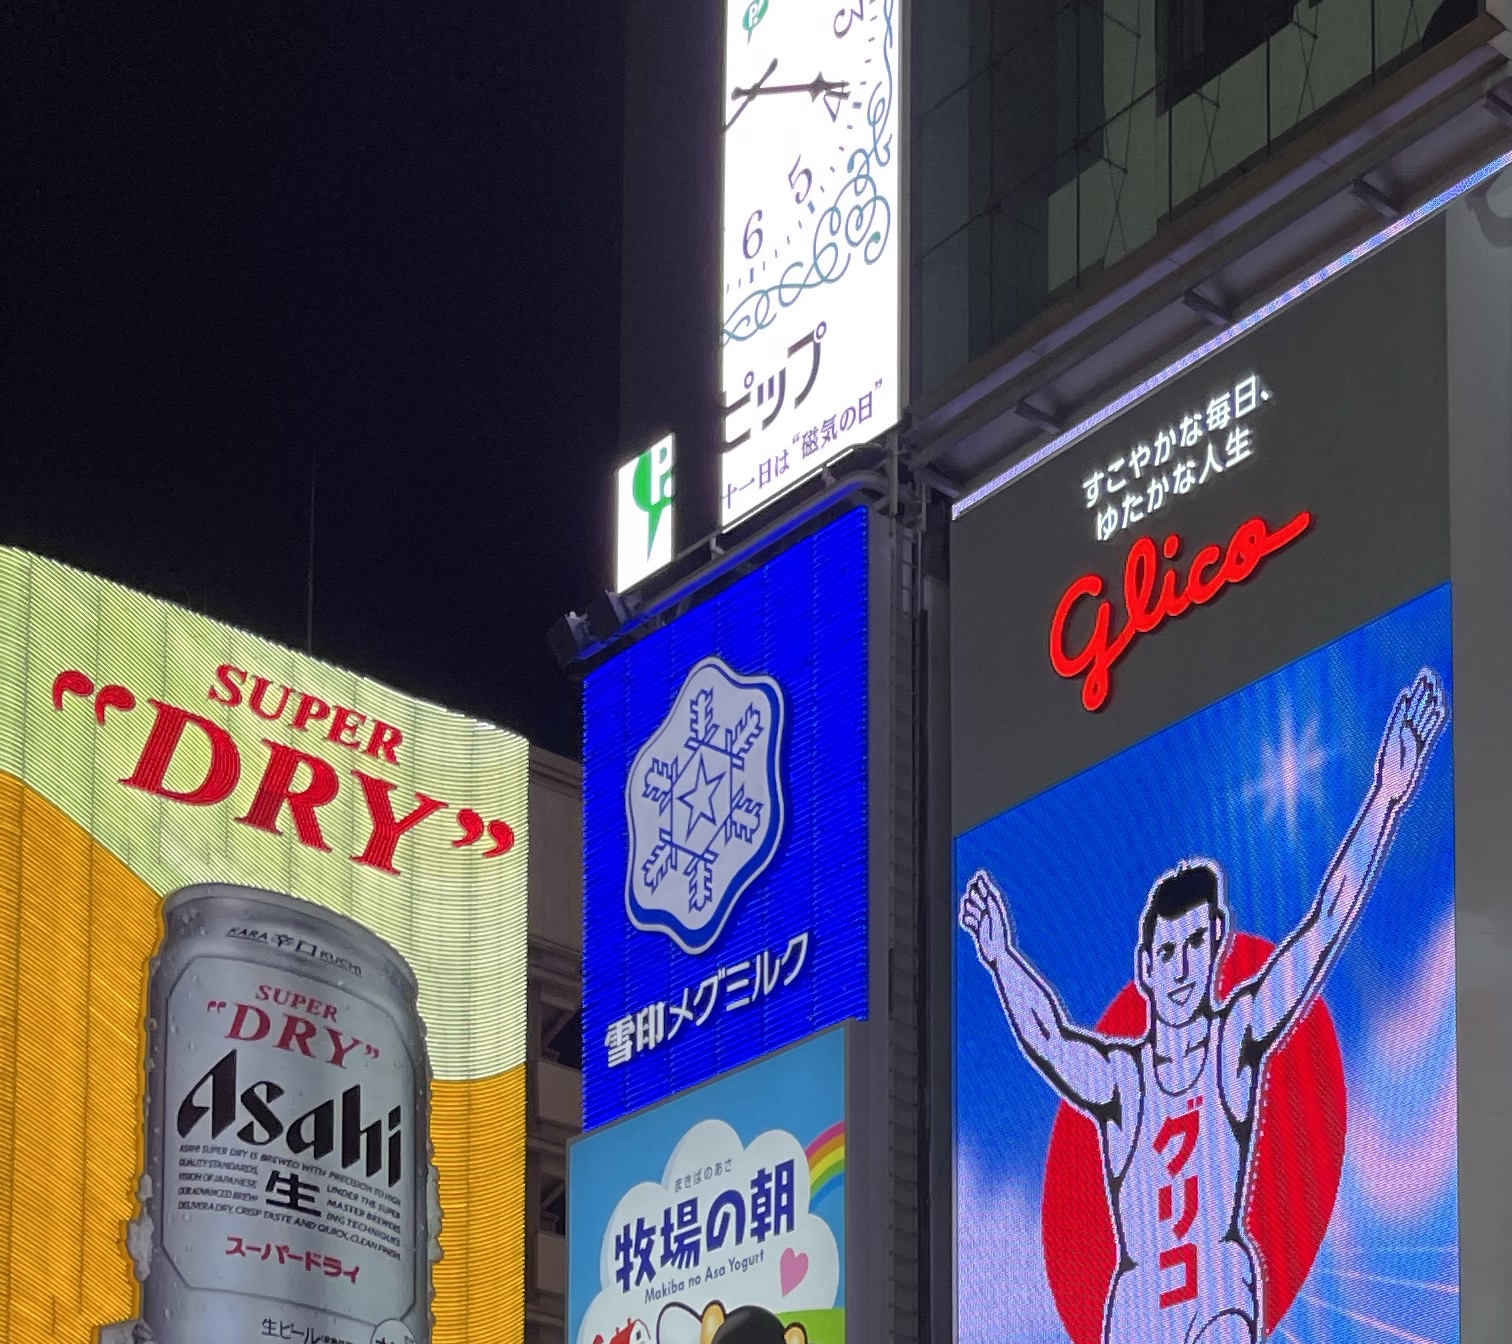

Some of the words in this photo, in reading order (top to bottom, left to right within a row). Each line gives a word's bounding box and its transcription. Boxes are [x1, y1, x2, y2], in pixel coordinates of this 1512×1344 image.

[788, 154, 812, 204] 5
[743, 210, 763, 259] 6
[1082, 374, 1273, 508] すこやかな毎日、
[1095, 427, 1255, 542] ゆたかな人生
[1050, 511, 1311, 711] Glico
[208, 662, 404, 765] SUPER
[256, 984, 338, 1022] SUPER
[603, 932, 810, 1069] 雪印メグミルク
[177, 1048, 402, 1189] Asahi
[265, 1170, 322, 1217] 生
[614, 1158, 796, 1293] 牧場の朝
[673, 1157, 734, 1193] まきばのあさ
[1153, 1095, 1206, 1309] グリコ
[225, 1236, 361, 1284] スーパードライ
[643, 1278, 686, 1305] Makiba
[687, 1272, 703, 1288] no
[704, 1264, 726, 1284] Asa
[727, 1248, 766, 1279] Yogurt
